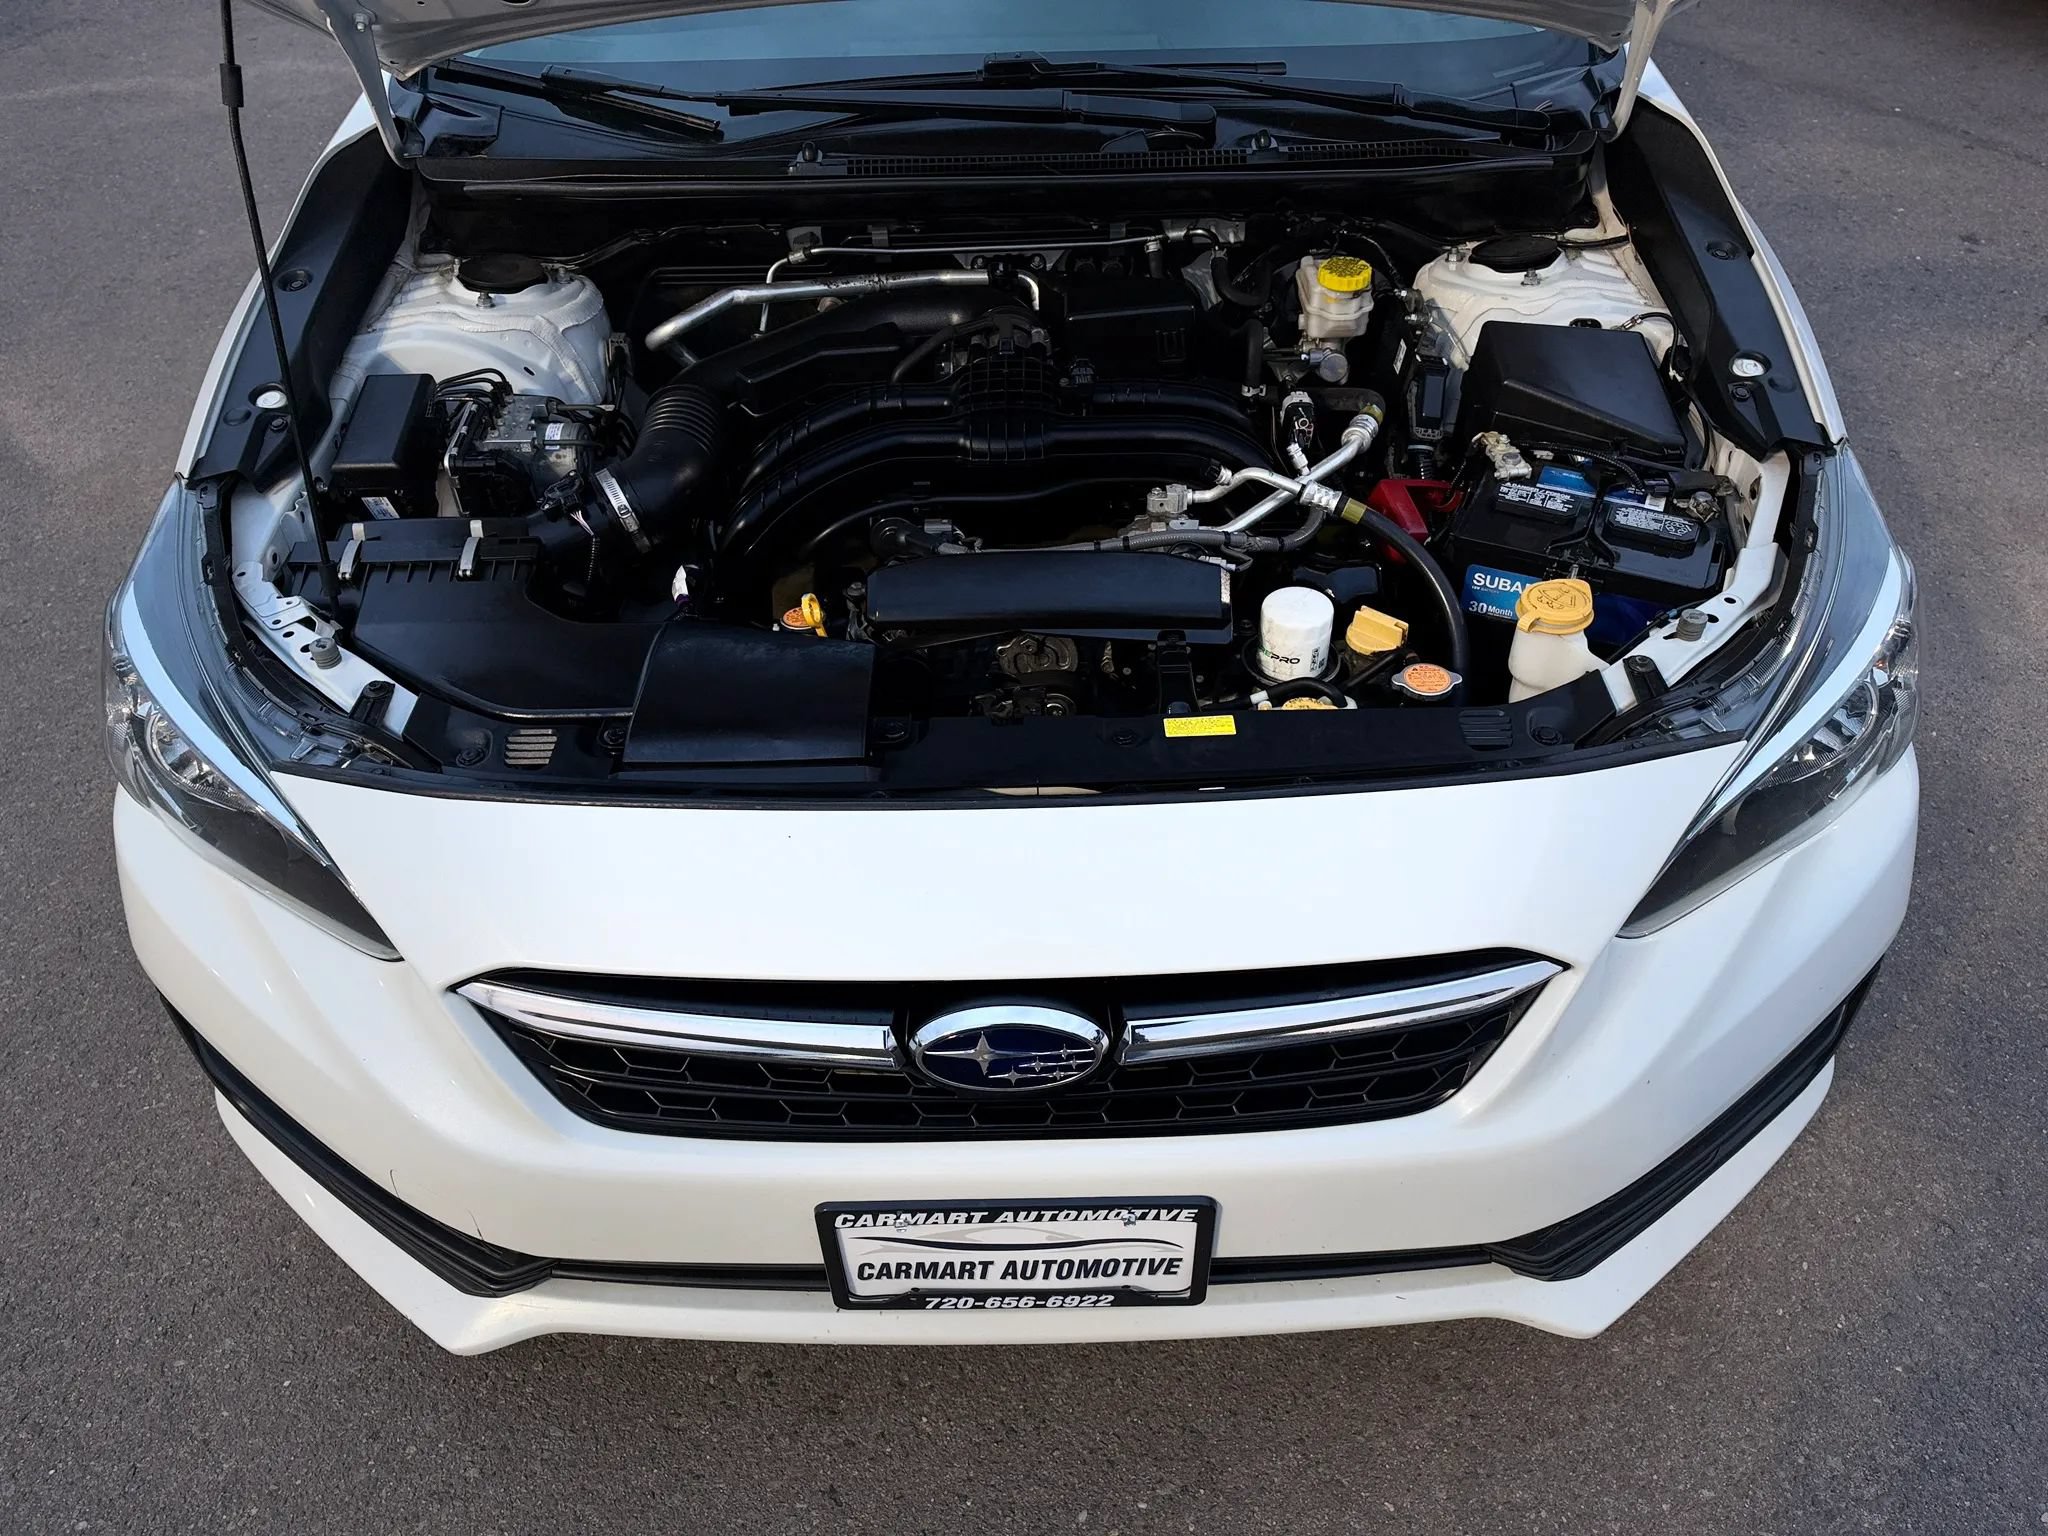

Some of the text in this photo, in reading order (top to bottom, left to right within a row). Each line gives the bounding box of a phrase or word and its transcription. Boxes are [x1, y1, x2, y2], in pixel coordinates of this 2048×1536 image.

[1468, 600, 1488, 614] 30
[1487, 605, 1513, 617] Month
[834, 1208, 1199, 1228] CARMART AUTOMOTIVE
[857, 1257, 1183, 1280] CARMART AUTOMOTIVE
[924, 1294, 1115, 1309] 720-656-6922
